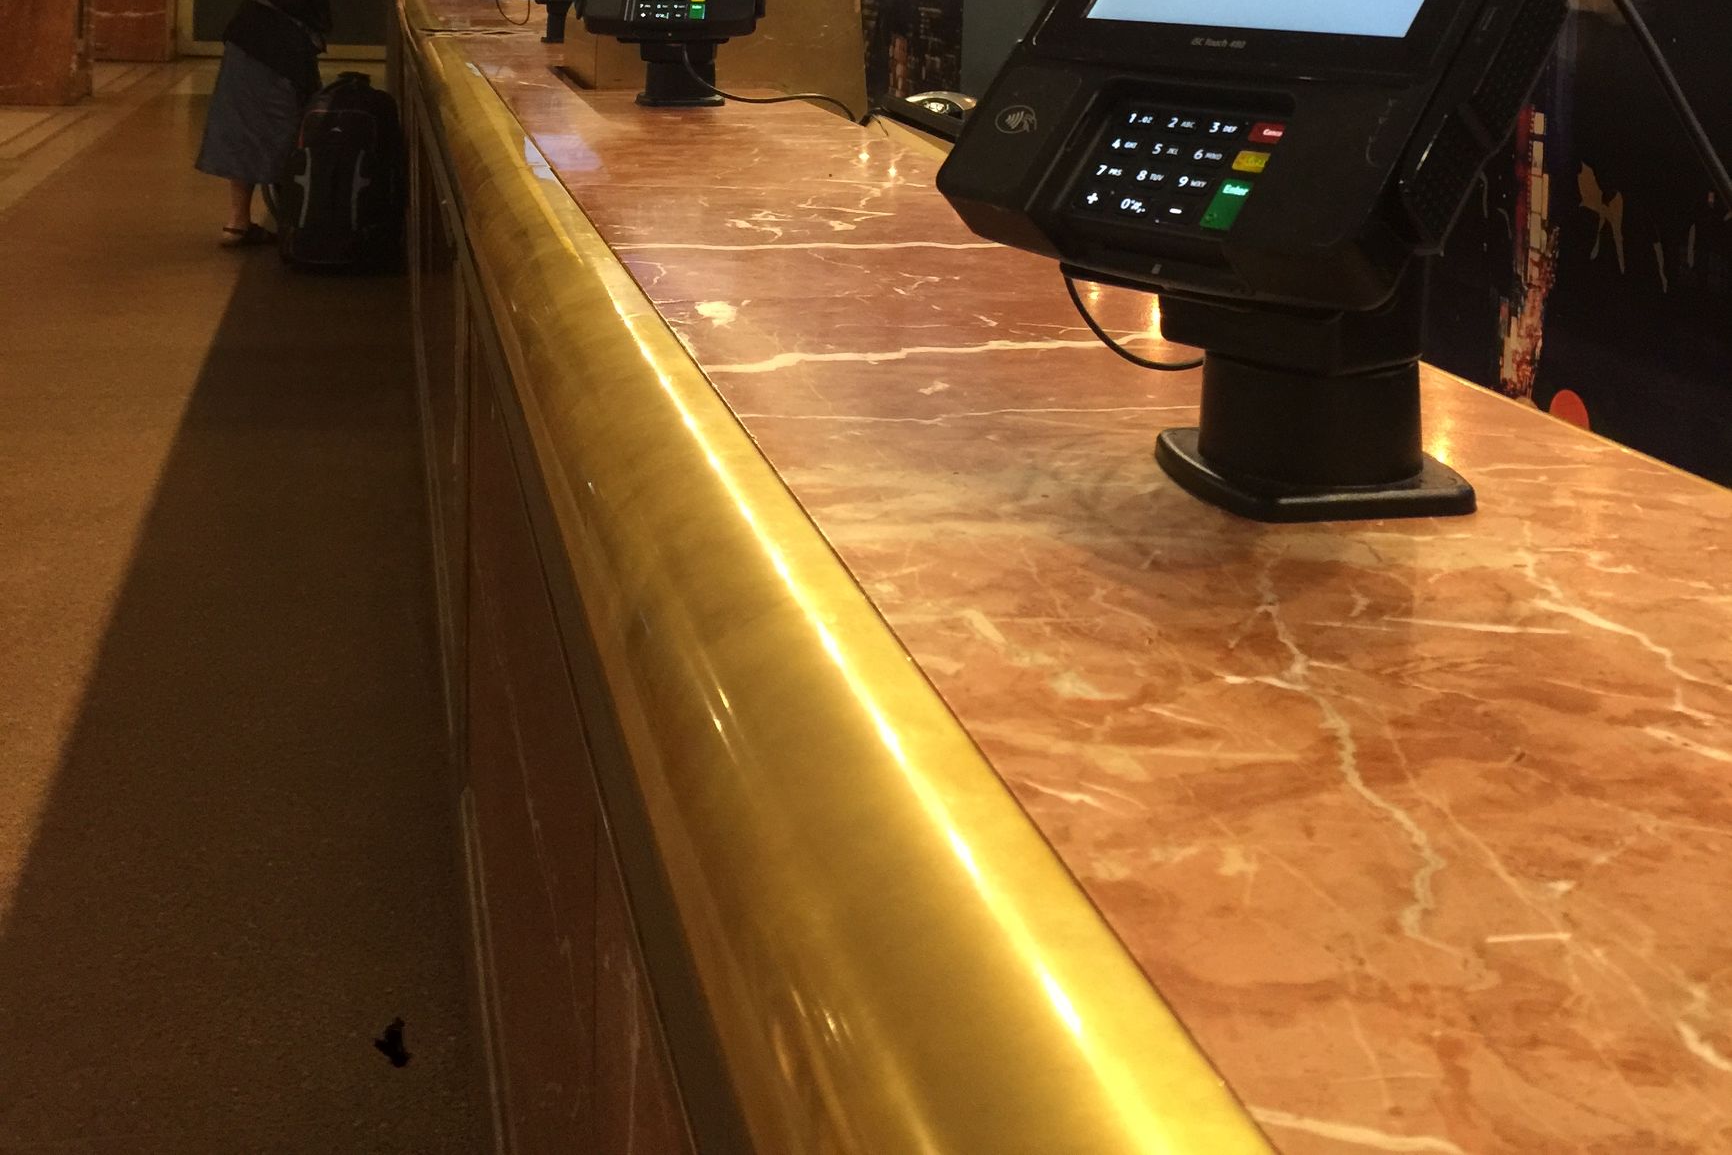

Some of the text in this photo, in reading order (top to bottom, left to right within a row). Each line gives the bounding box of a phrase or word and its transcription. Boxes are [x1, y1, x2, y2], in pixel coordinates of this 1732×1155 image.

[1128, 113, 1137, 124] 1
[1167, 117, 1178, 128] 2
[1209, 122, 1221, 133] 3
[1111, 138, 1121, 150] 4
[1152, 143, 1163, 155] 5
[1193, 149, 1203, 160] 6
[1096, 164, 1107, 176] 7
[1136, 170, 1148, 181] 8
[1178, 176, 1189, 187] 9
[1222, 184, 1250, 196] Enter
